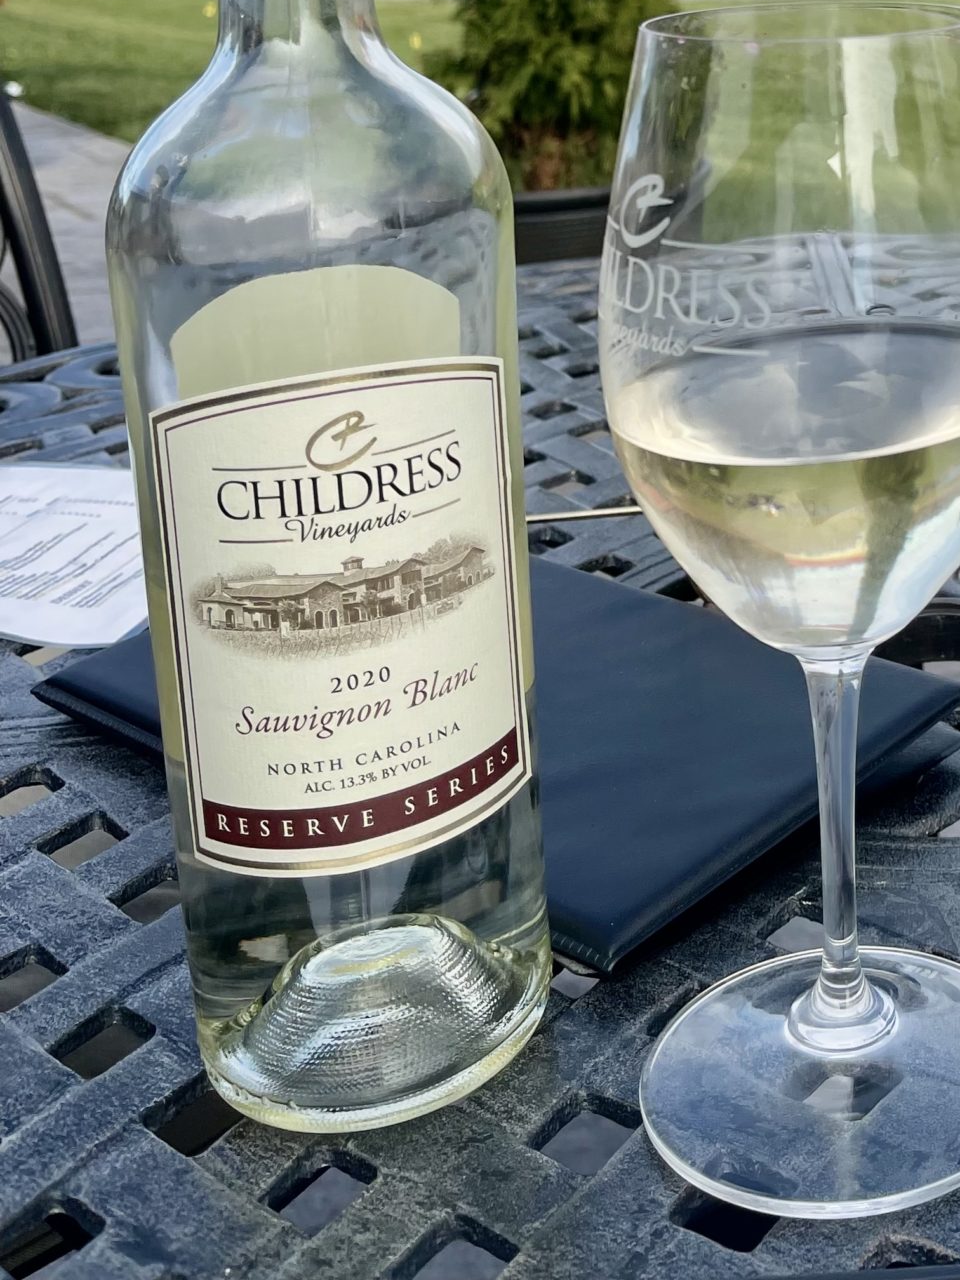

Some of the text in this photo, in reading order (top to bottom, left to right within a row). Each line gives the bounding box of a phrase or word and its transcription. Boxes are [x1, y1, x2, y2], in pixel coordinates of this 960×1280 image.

[216, 440, 463, 521] CHILDRESS
[284, 504, 411, 543] Vineyards
[235, 662, 479, 739] Sauvignon Blanc
[330, 666, 392, 694] 2020
[267, 721, 462, 776] NORTH CAROLINA
[216, 744, 509, 838] RESERVE SERIES
[303, 780, 335, 794] ALC.
[340, 772, 378, 789] 13.3%
[382, 765, 398, 779] BY
